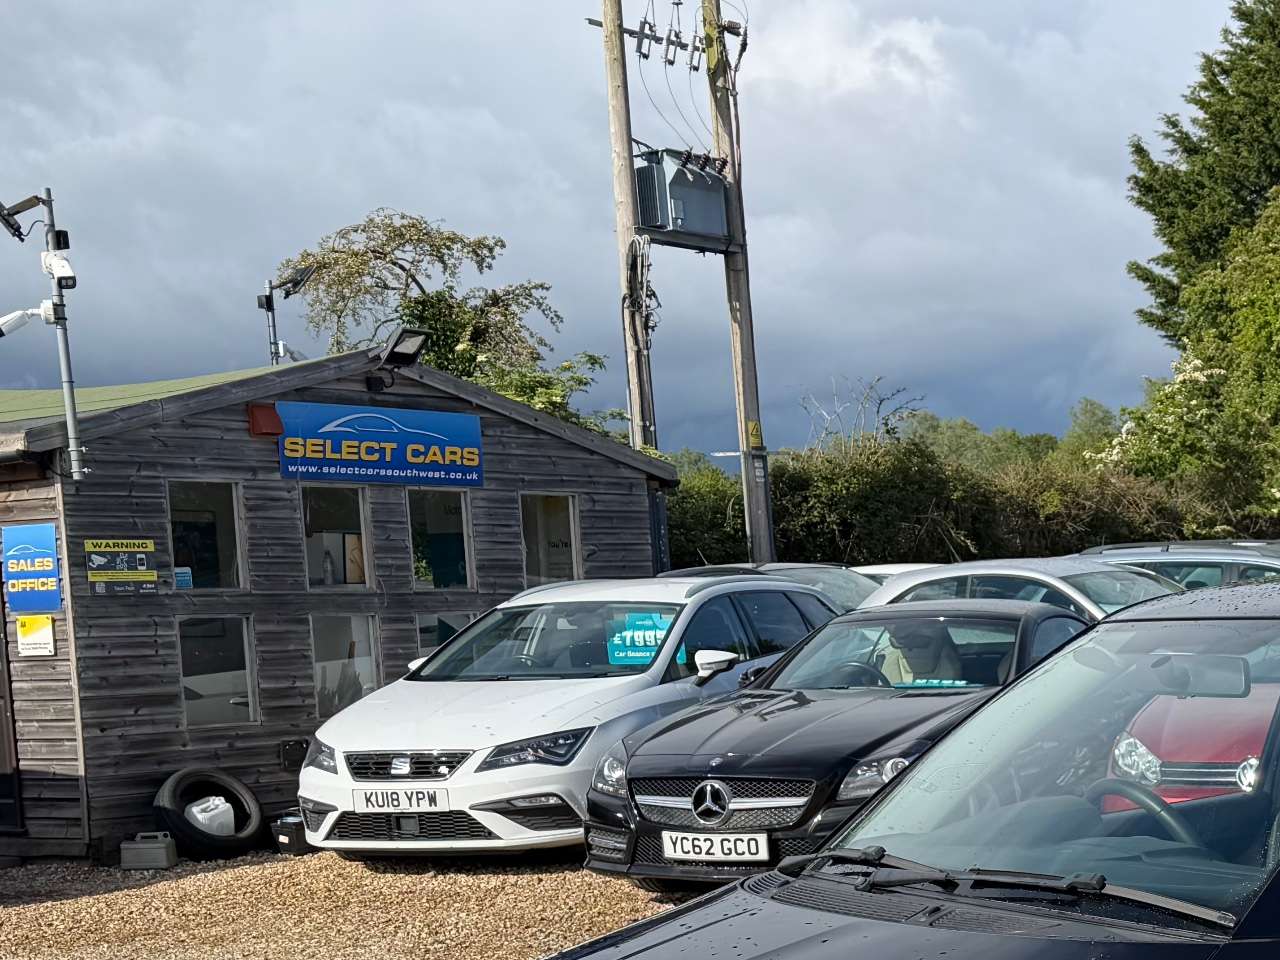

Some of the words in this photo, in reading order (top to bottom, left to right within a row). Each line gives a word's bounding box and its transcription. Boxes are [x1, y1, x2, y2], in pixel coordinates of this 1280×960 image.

[284, 437, 397, 462] SELECT
[406, 443, 480, 467] CARS
[287, 464, 479, 480] www.selectcarssouthwest.co.uk
[91, 541, 149, 549] WARNING
[8, 557, 54, 572] SALES
[8, 578, 57, 592] OFFICE
[364, 791, 400, 808] KU18
[404, 790, 438, 808] YPW
[669, 835, 715, 856] YC62
[720, 837, 760, 856] GCO
